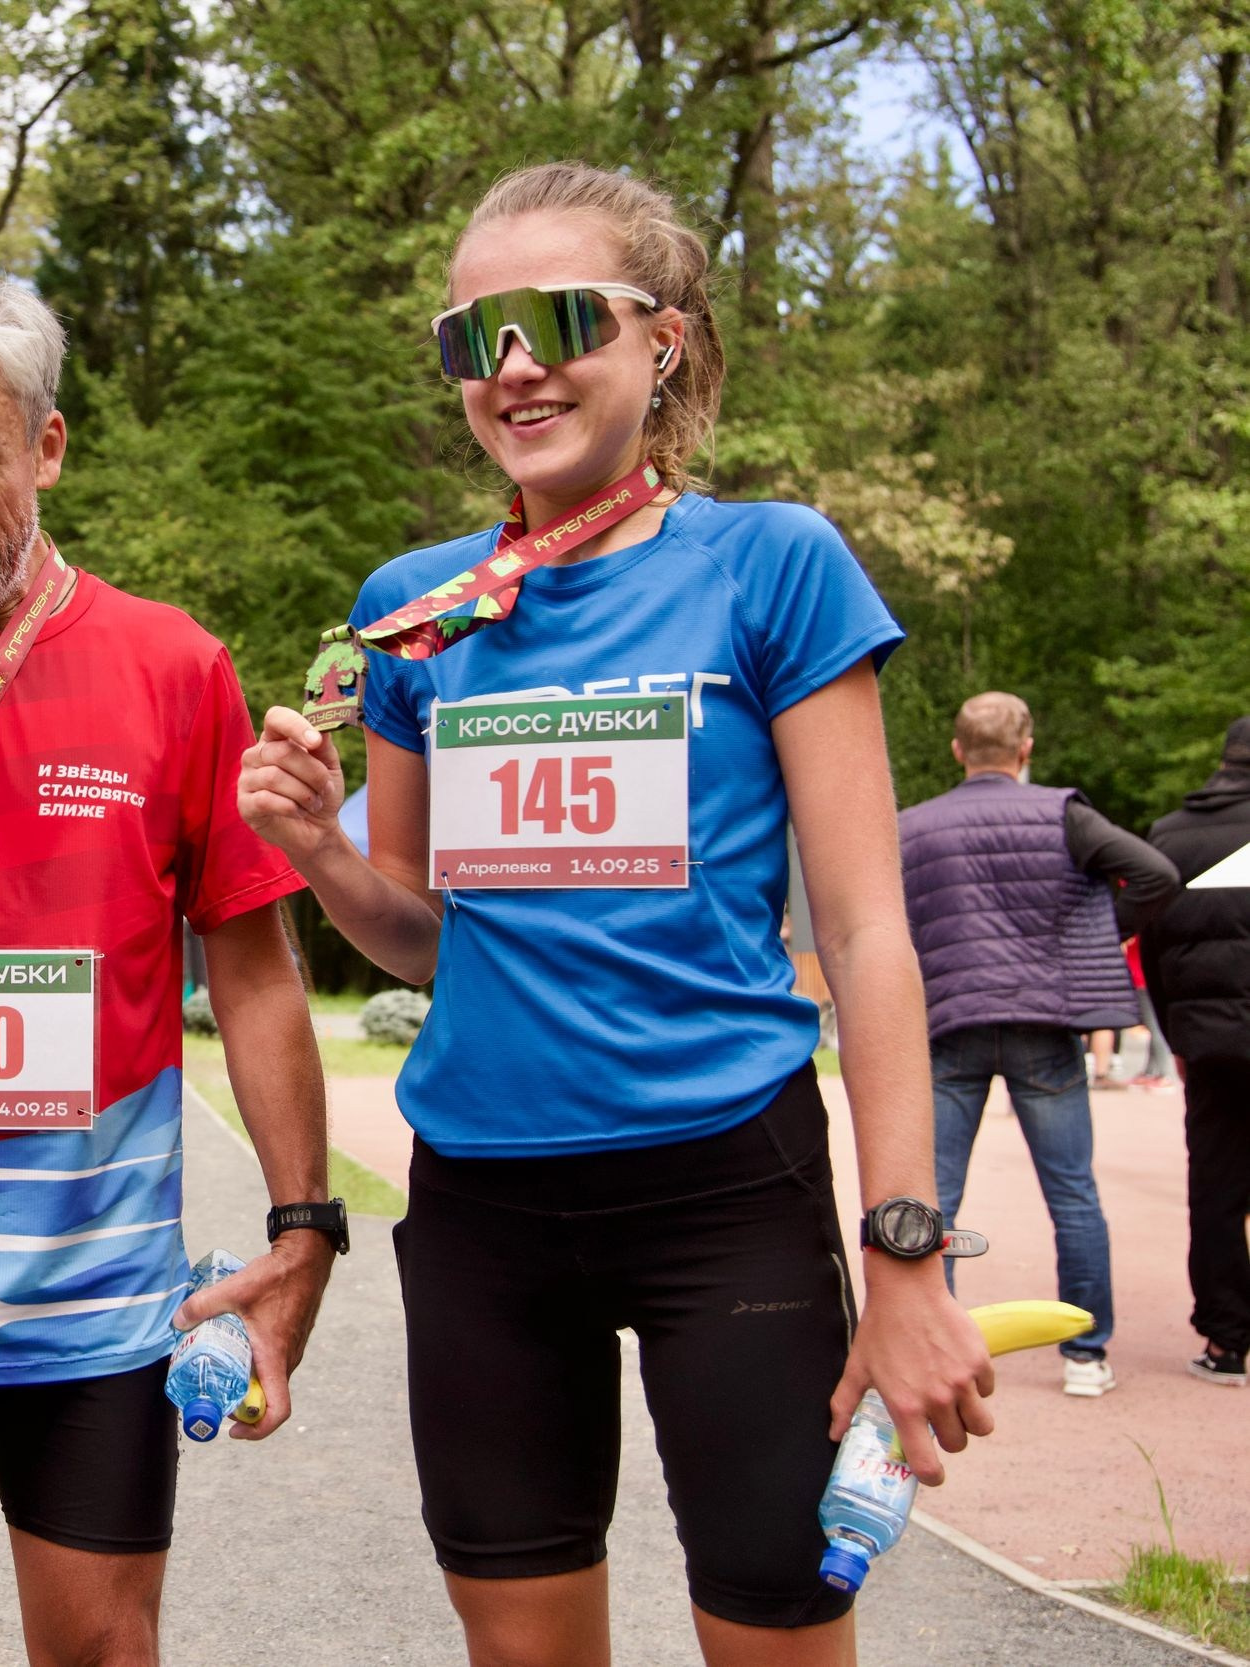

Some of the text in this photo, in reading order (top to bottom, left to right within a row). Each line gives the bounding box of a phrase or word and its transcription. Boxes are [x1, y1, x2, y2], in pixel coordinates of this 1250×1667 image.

[533, 488, 633, 553] АПРЕЛЕВКА
[3, 578, 57, 662] АПРЕЛЕВКА
[458, 708, 658, 738] КРОСС ДУБКИ
[38, 763, 129, 785] И ЗВЁЗДЫ
[38, 783, 146, 809] СТАНОВЯТСЯ
[490, 755, 617, 836] 145
[38, 803, 106, 819] БЛИЖЕ
[456, 857, 661, 878] Апрелевка 14.09.25
[751, 1300, 813, 1312] DEMIX
